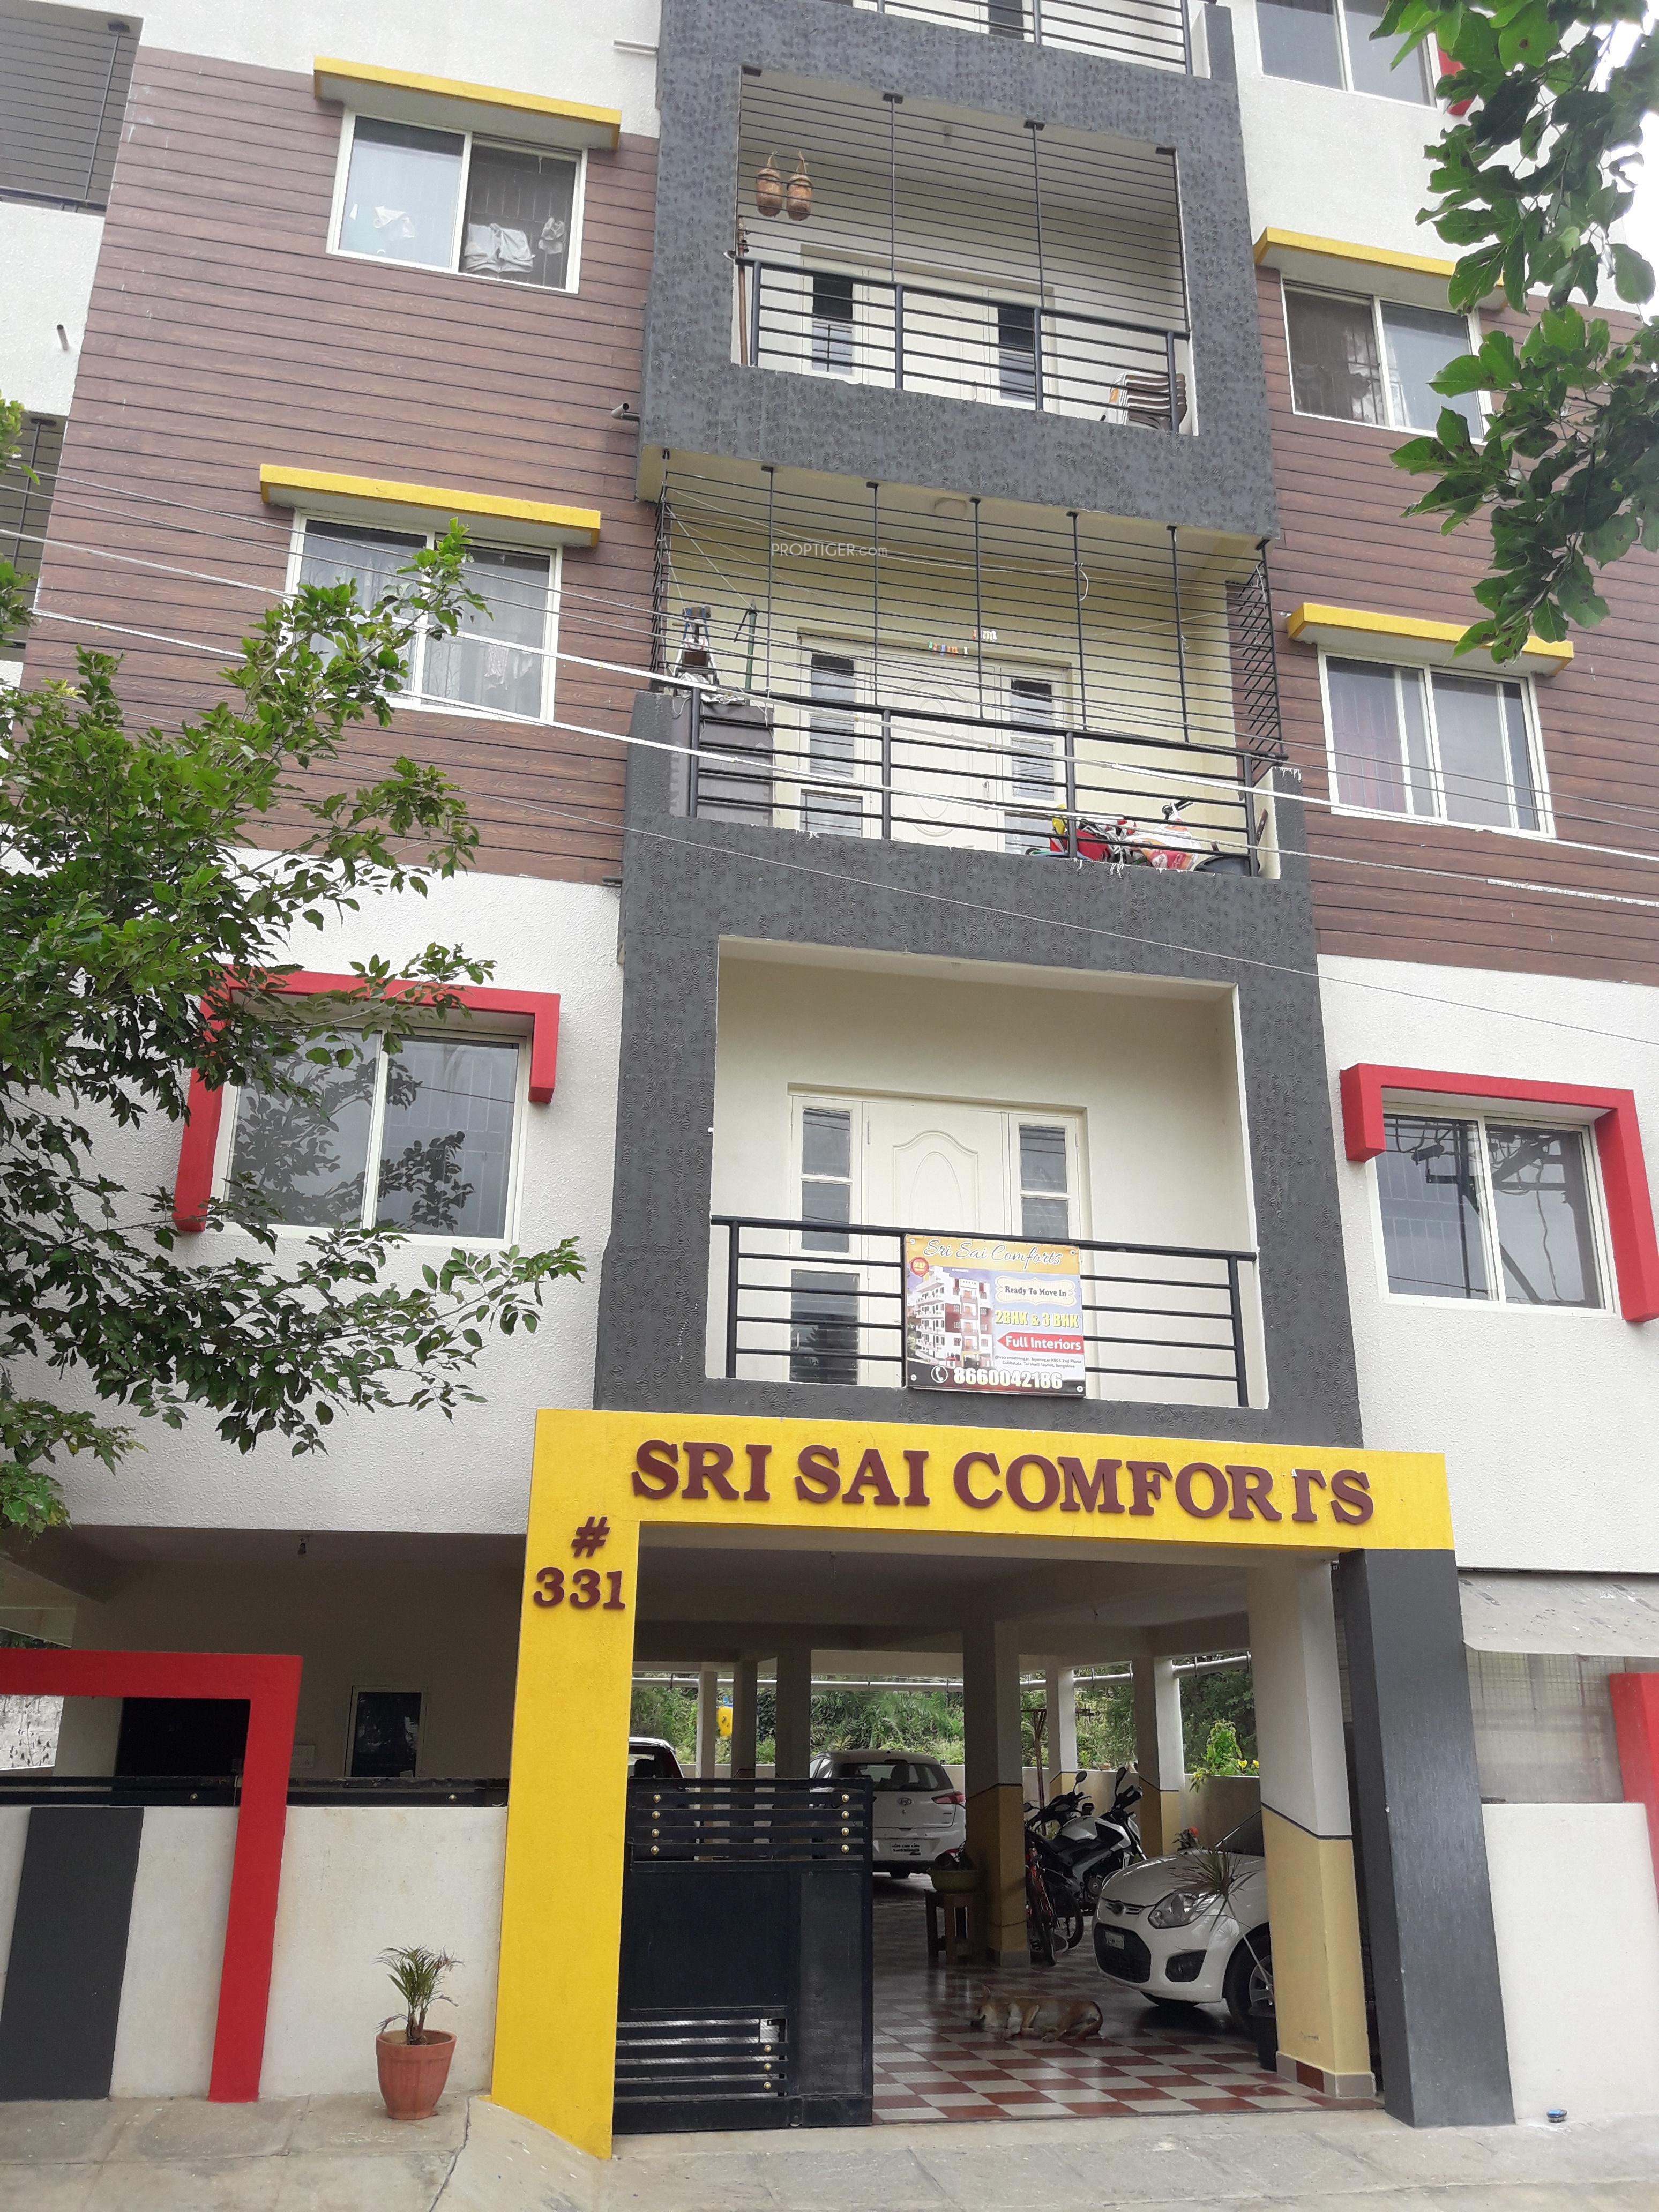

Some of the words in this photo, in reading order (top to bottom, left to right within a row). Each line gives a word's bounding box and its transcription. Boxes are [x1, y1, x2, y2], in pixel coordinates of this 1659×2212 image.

[924, 1240, 952, 1257] Sri
[956, 1242, 987, 1259] Sai
[991, 1244, 1063, 1269] Comforts
[1005, 1286, 1027, 1296] Ready
[1039, 1288, 1057, 1296] Move
[994, 1310, 1029, 1326] 2BHK
[1030, 1314, 1040, 1326] &
[1042, 1313, 1050, 1327] 3
[1053, 1314, 1079, 1328] BHK
[1005, 1336, 1028, 1348] Full
[1030, 1337, 1081, 1350] Interiors
[954, 1367, 1063, 1389] 8660042186
[631, 1439, 772, 1501] SRI
[794, 1444, 931, 1506] SAI
[953, 1451, 1374, 1525] COMFORTS
[570, 1516, 611, 1558] #
[533, 1566, 626, 1610] 331
